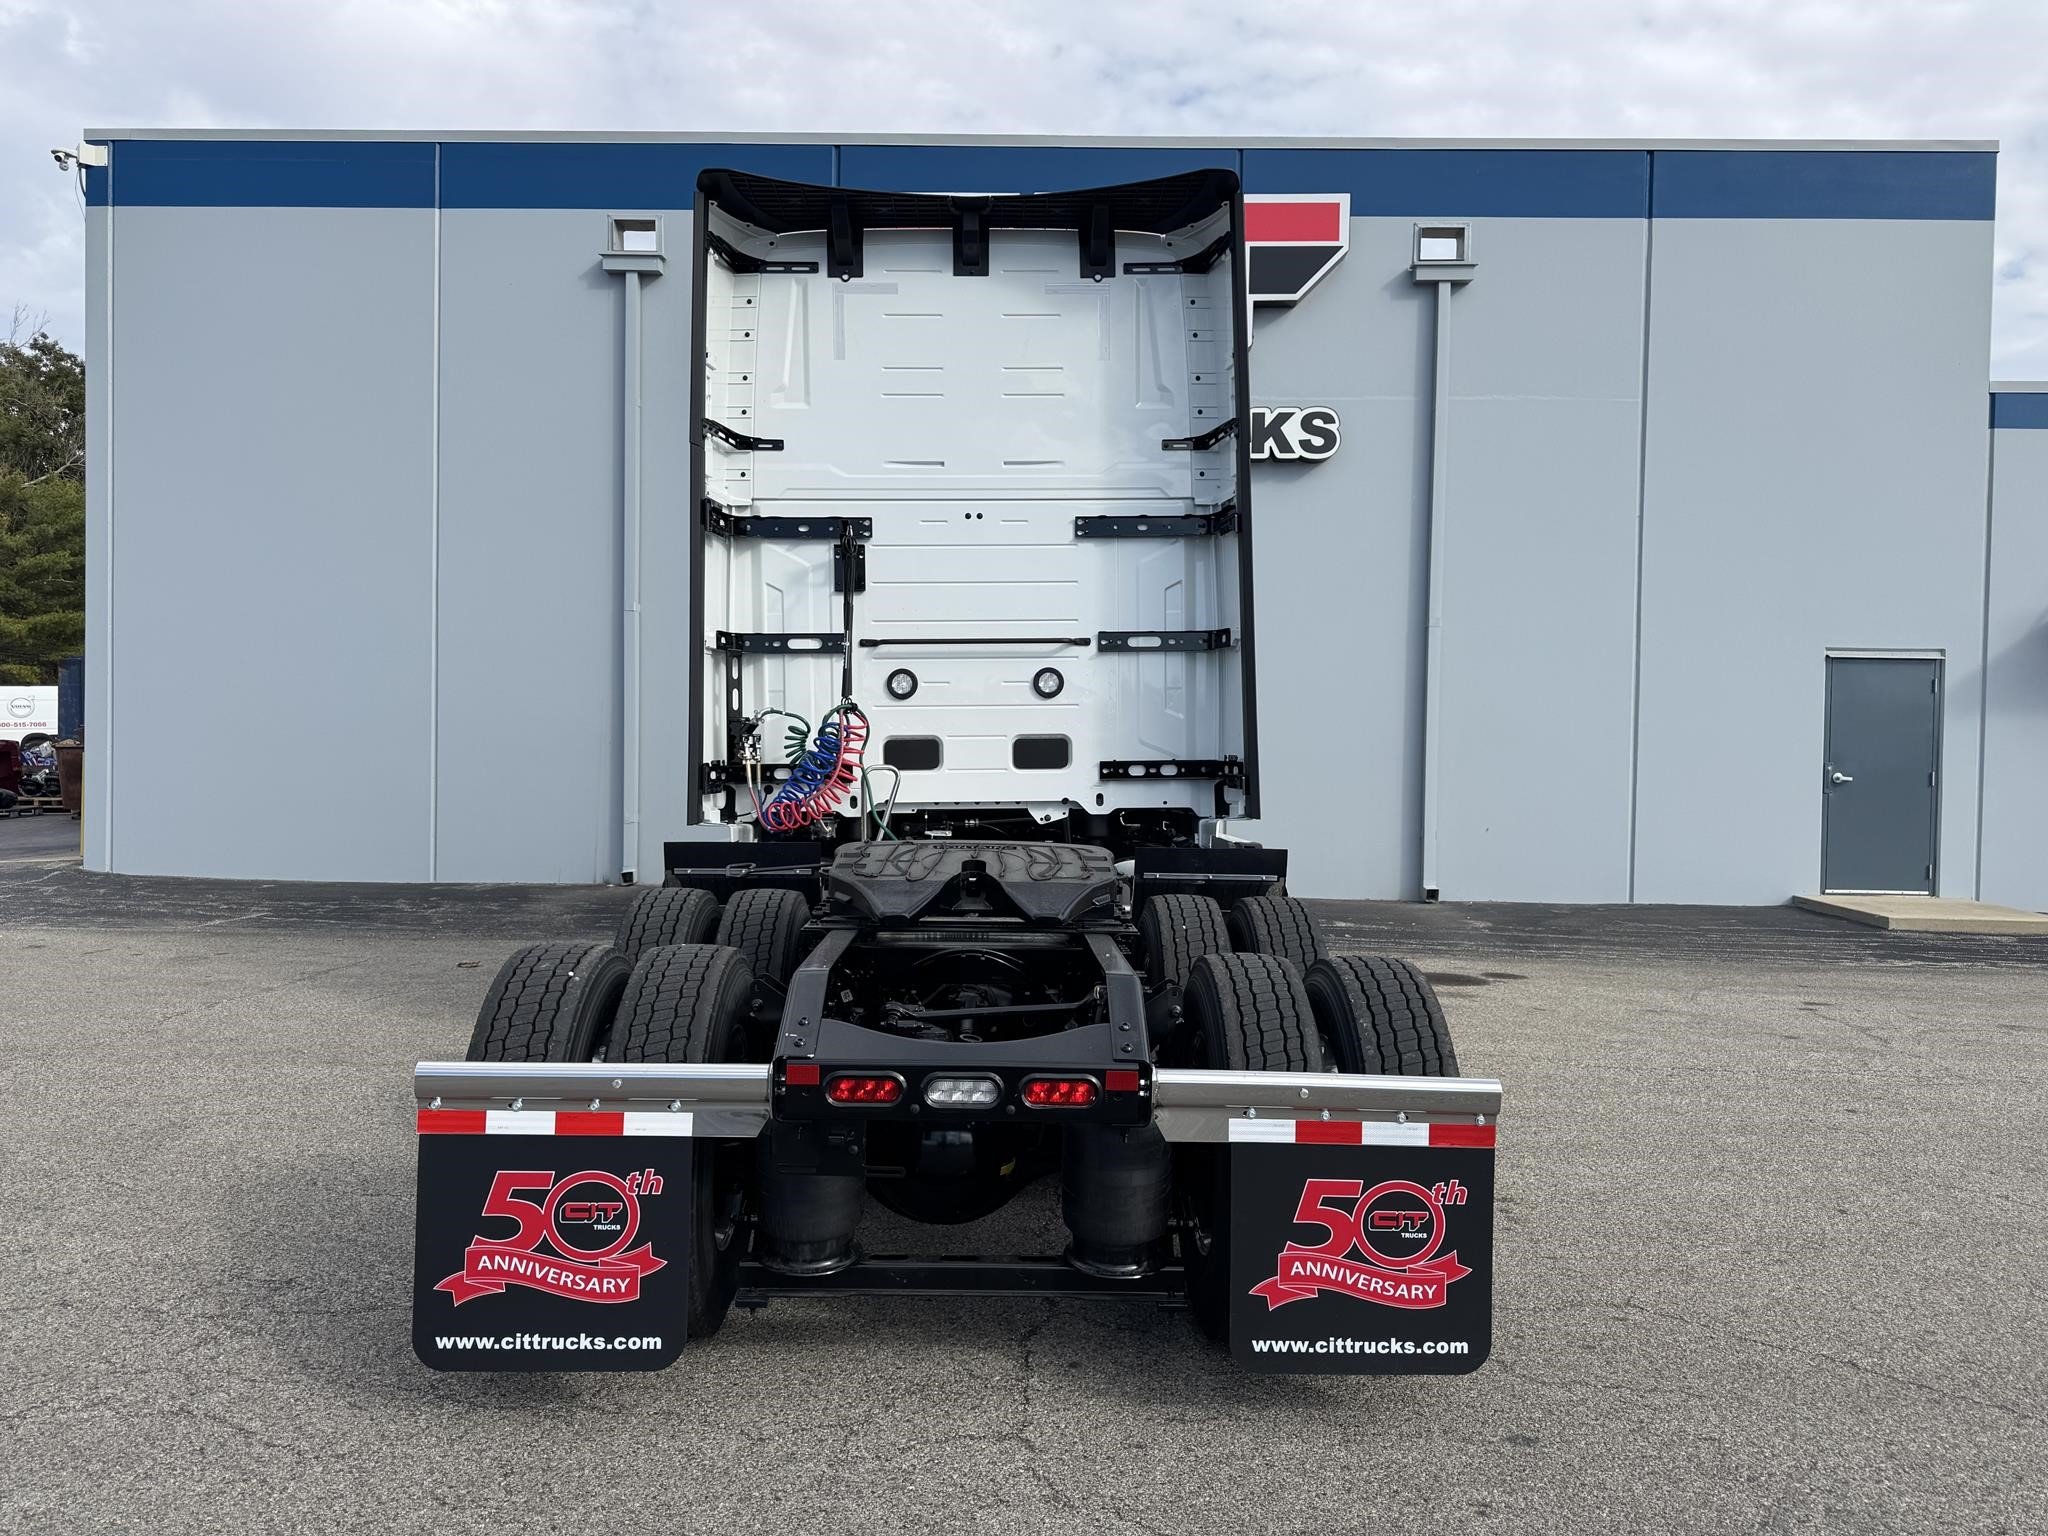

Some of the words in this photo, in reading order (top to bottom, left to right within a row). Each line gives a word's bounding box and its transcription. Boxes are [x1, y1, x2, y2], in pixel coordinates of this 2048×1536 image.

[559, 1202, 623, 1223] CIT
[1368, 1211, 1429, 1232] CIT
[478, 1255, 630, 1293] ANNIVERSARY
[1291, 1261, 1437, 1300] ANNIVERSARY
[435, 1333, 662, 1351] www.cittrucks.com
[1252, 1337, 1469, 1354] www.cittrucks.com
